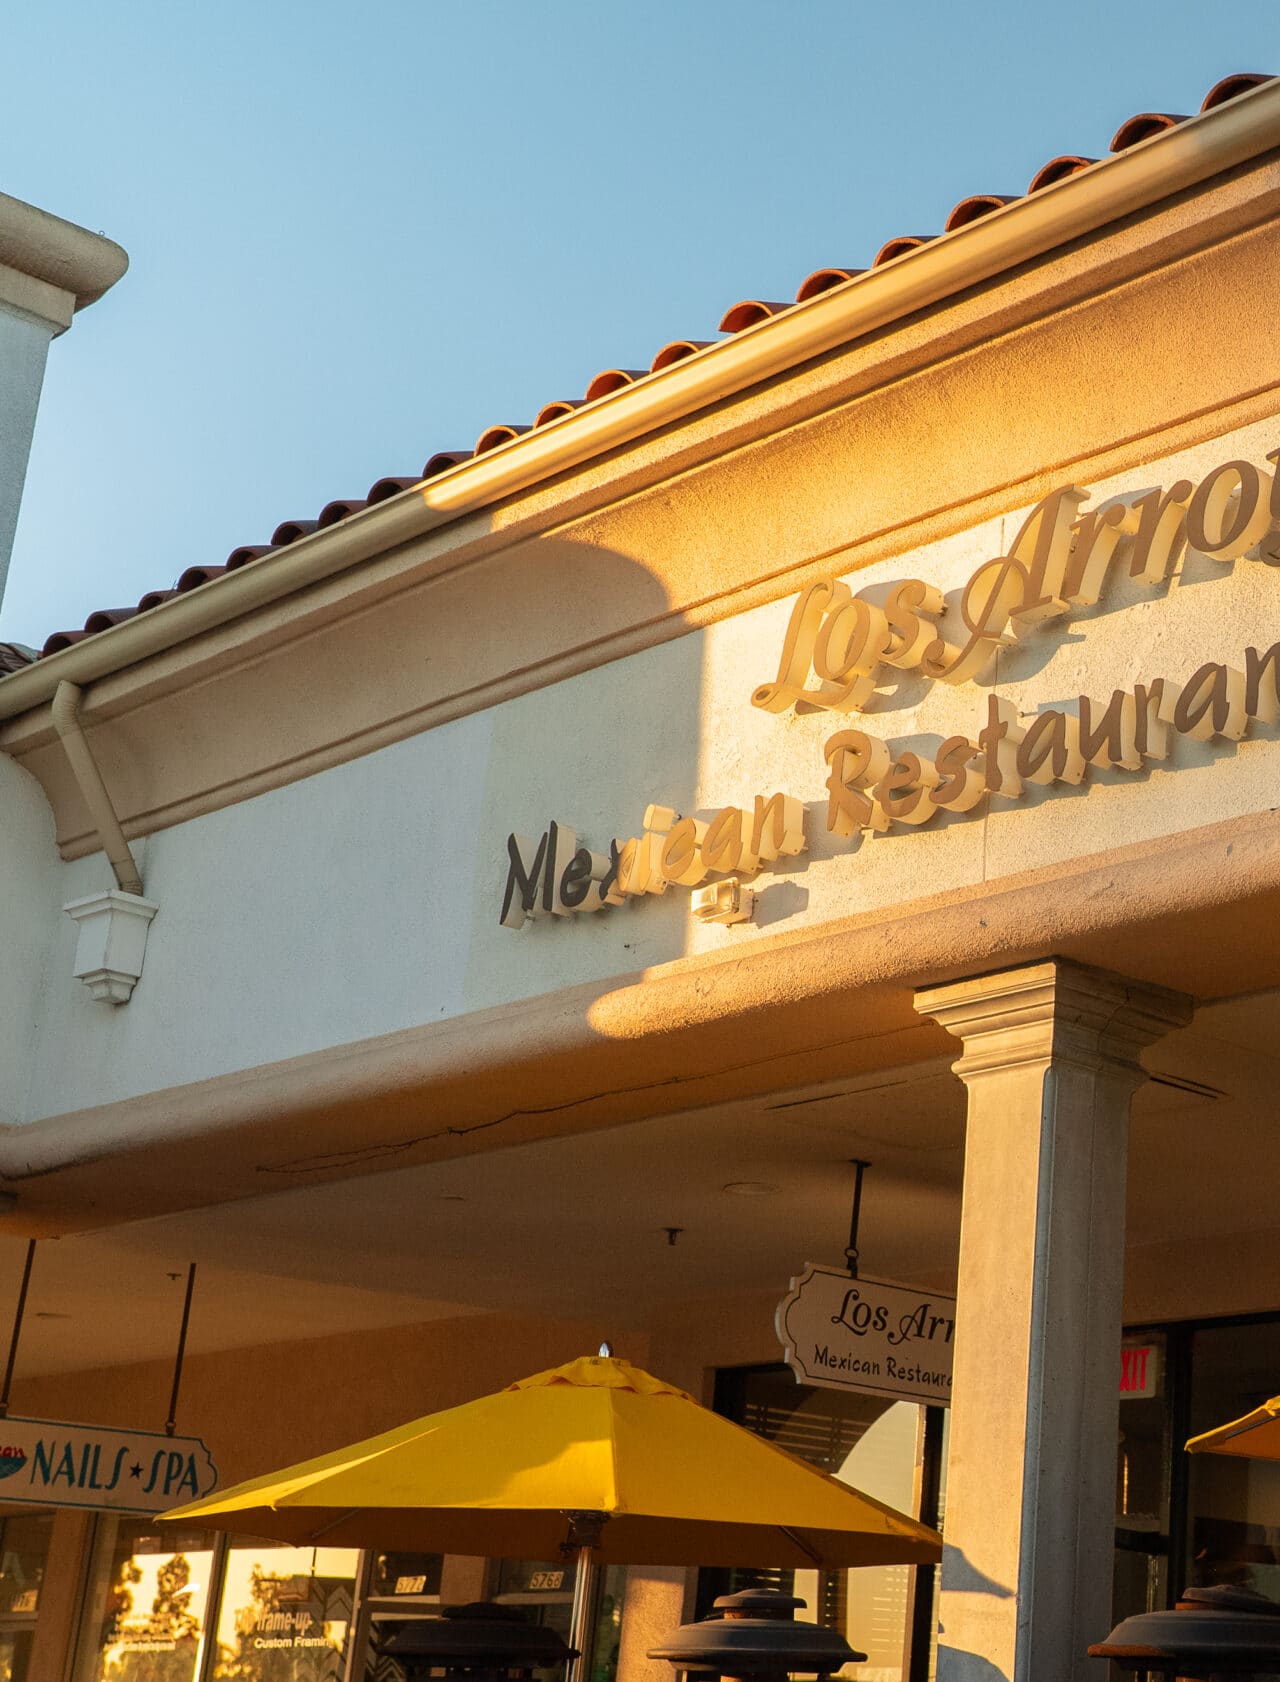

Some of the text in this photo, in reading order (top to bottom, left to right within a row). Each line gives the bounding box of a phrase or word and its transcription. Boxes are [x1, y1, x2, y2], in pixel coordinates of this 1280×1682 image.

[751, 577, 946, 713] Los
[500, 793, 798, 926] Mexican
[831, 1289, 889, 1336] Los
[814, 1344, 881, 1375] Mexican
[29, 1439, 199, 1497] NAILS SPA
[254, 1637, 293, 1649] Custom
